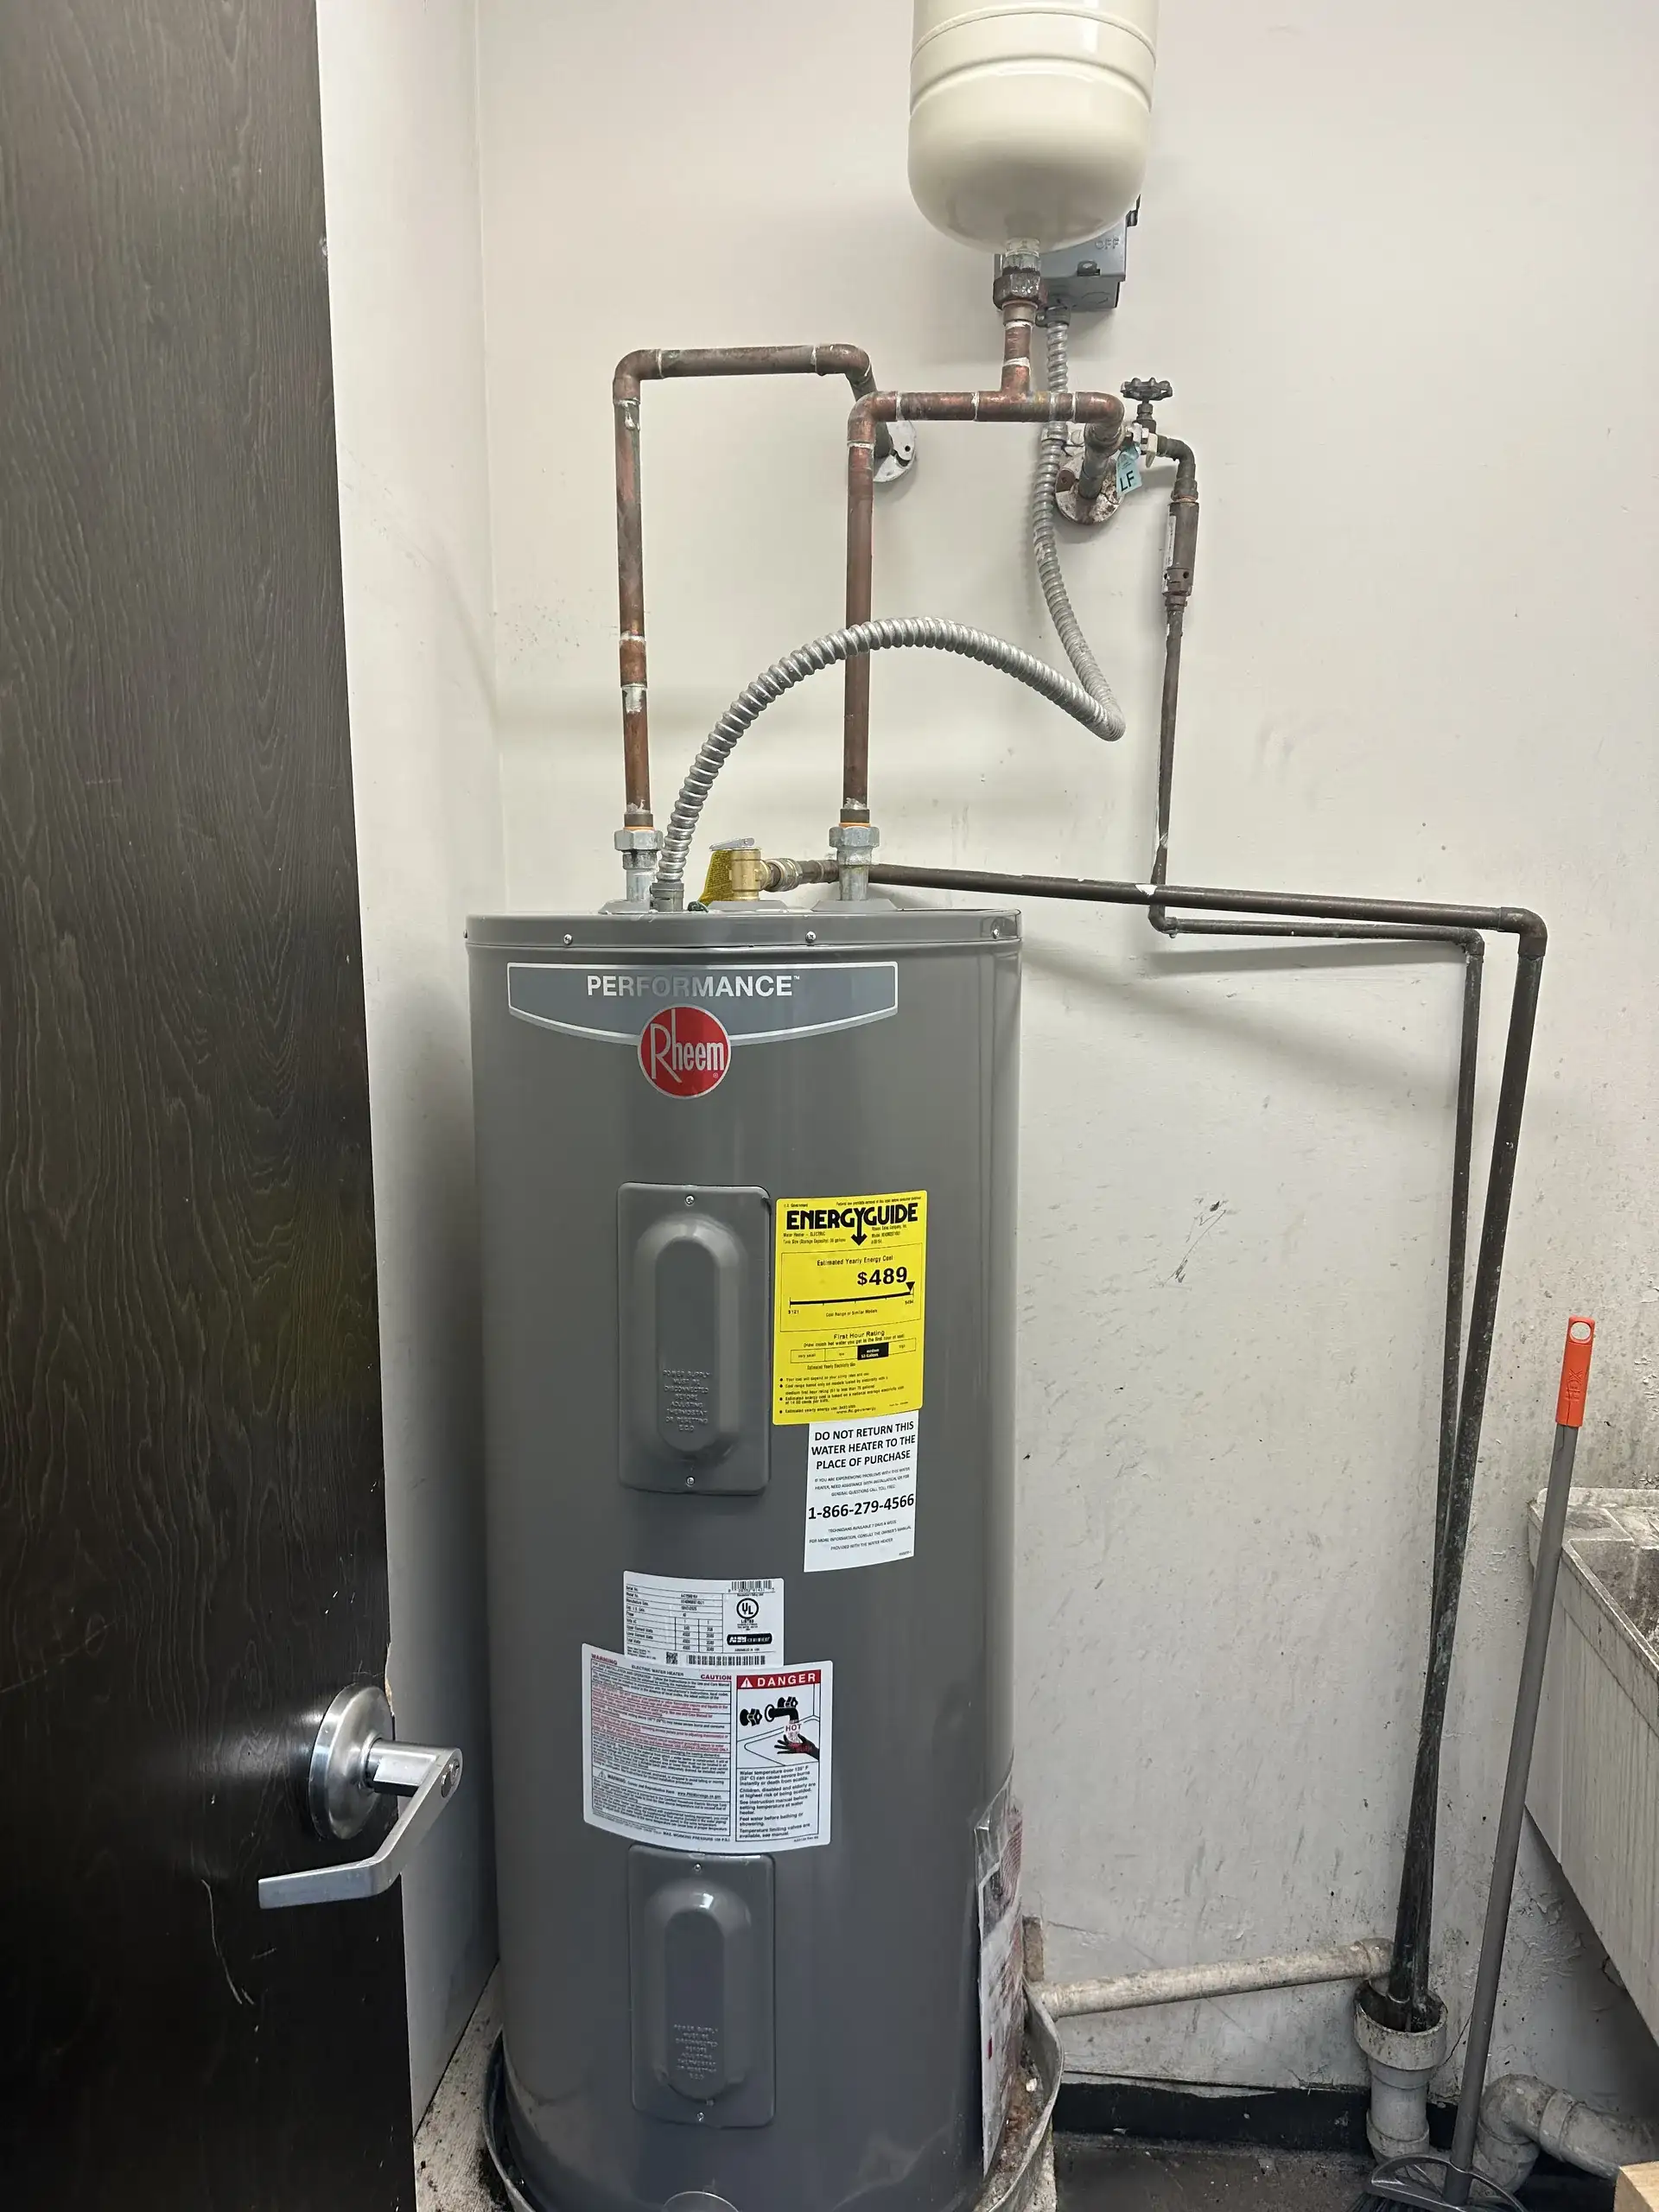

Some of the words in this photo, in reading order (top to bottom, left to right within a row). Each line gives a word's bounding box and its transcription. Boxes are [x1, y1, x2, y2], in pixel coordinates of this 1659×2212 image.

[1120, 470, 1134, 491] LF
[650, 1008, 724, 1083] Rheem
[787, 1203, 918, 1230] ENERGYGUIDE
[857, 1267, 907, 1286] $489
[1564, 1369, 1583, 1402] HDX
[815, 1432, 830, 1441] DO
[833, 1430, 854, 1440] NOT
[856, 1425, 893, 1438] RETURN
[895, 1421, 914, 1432] THIS
[811, 1445, 845, 1455] WATER
[849, 1440, 883, 1452] HEATER
[886, 1438, 897, 1447] TO
[900, 1435, 916, 1445] THE
[817, 1459, 846, 1470] PLACE
[849, 1458, 861, 1466] OF
[865, 1450, 911, 1465] PURCHASE
[808, 1494, 914, 1519] 1-866-279-4566
[742, 1603, 753, 1614] UL
[591, 1654, 617, 1665] WARNING
[757, 1673, 816, 1687] DANGER
